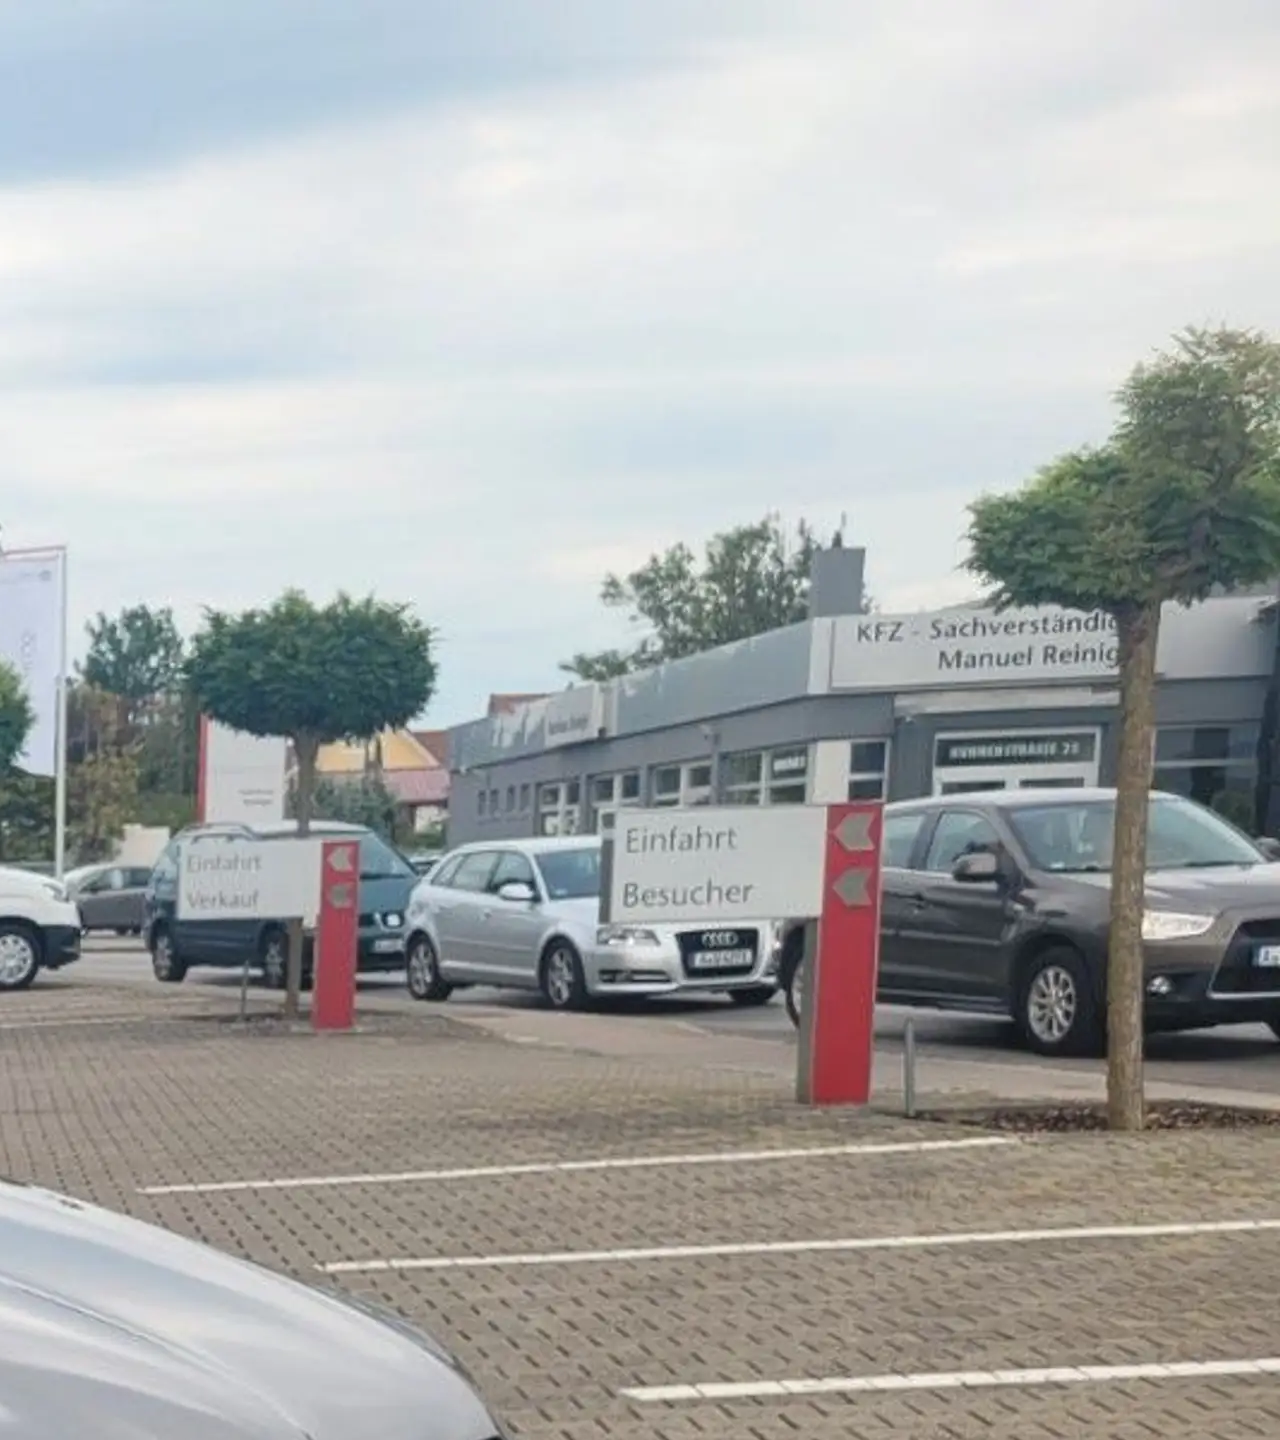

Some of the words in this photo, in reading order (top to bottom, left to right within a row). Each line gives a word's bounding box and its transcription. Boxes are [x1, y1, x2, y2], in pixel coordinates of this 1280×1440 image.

[857, 621, 904, 644] KFZ
[930, 609, 1118, 640] Sachverständig
[938, 647, 1033, 671] Manuel
[1042, 641, 1119, 669] Reinig
[626, 825, 738, 853] Einfahrt
[187, 853, 262, 874] Einfahrt
[187, 889, 259, 910] Verkauf
[622, 879, 754, 909] Besucher
